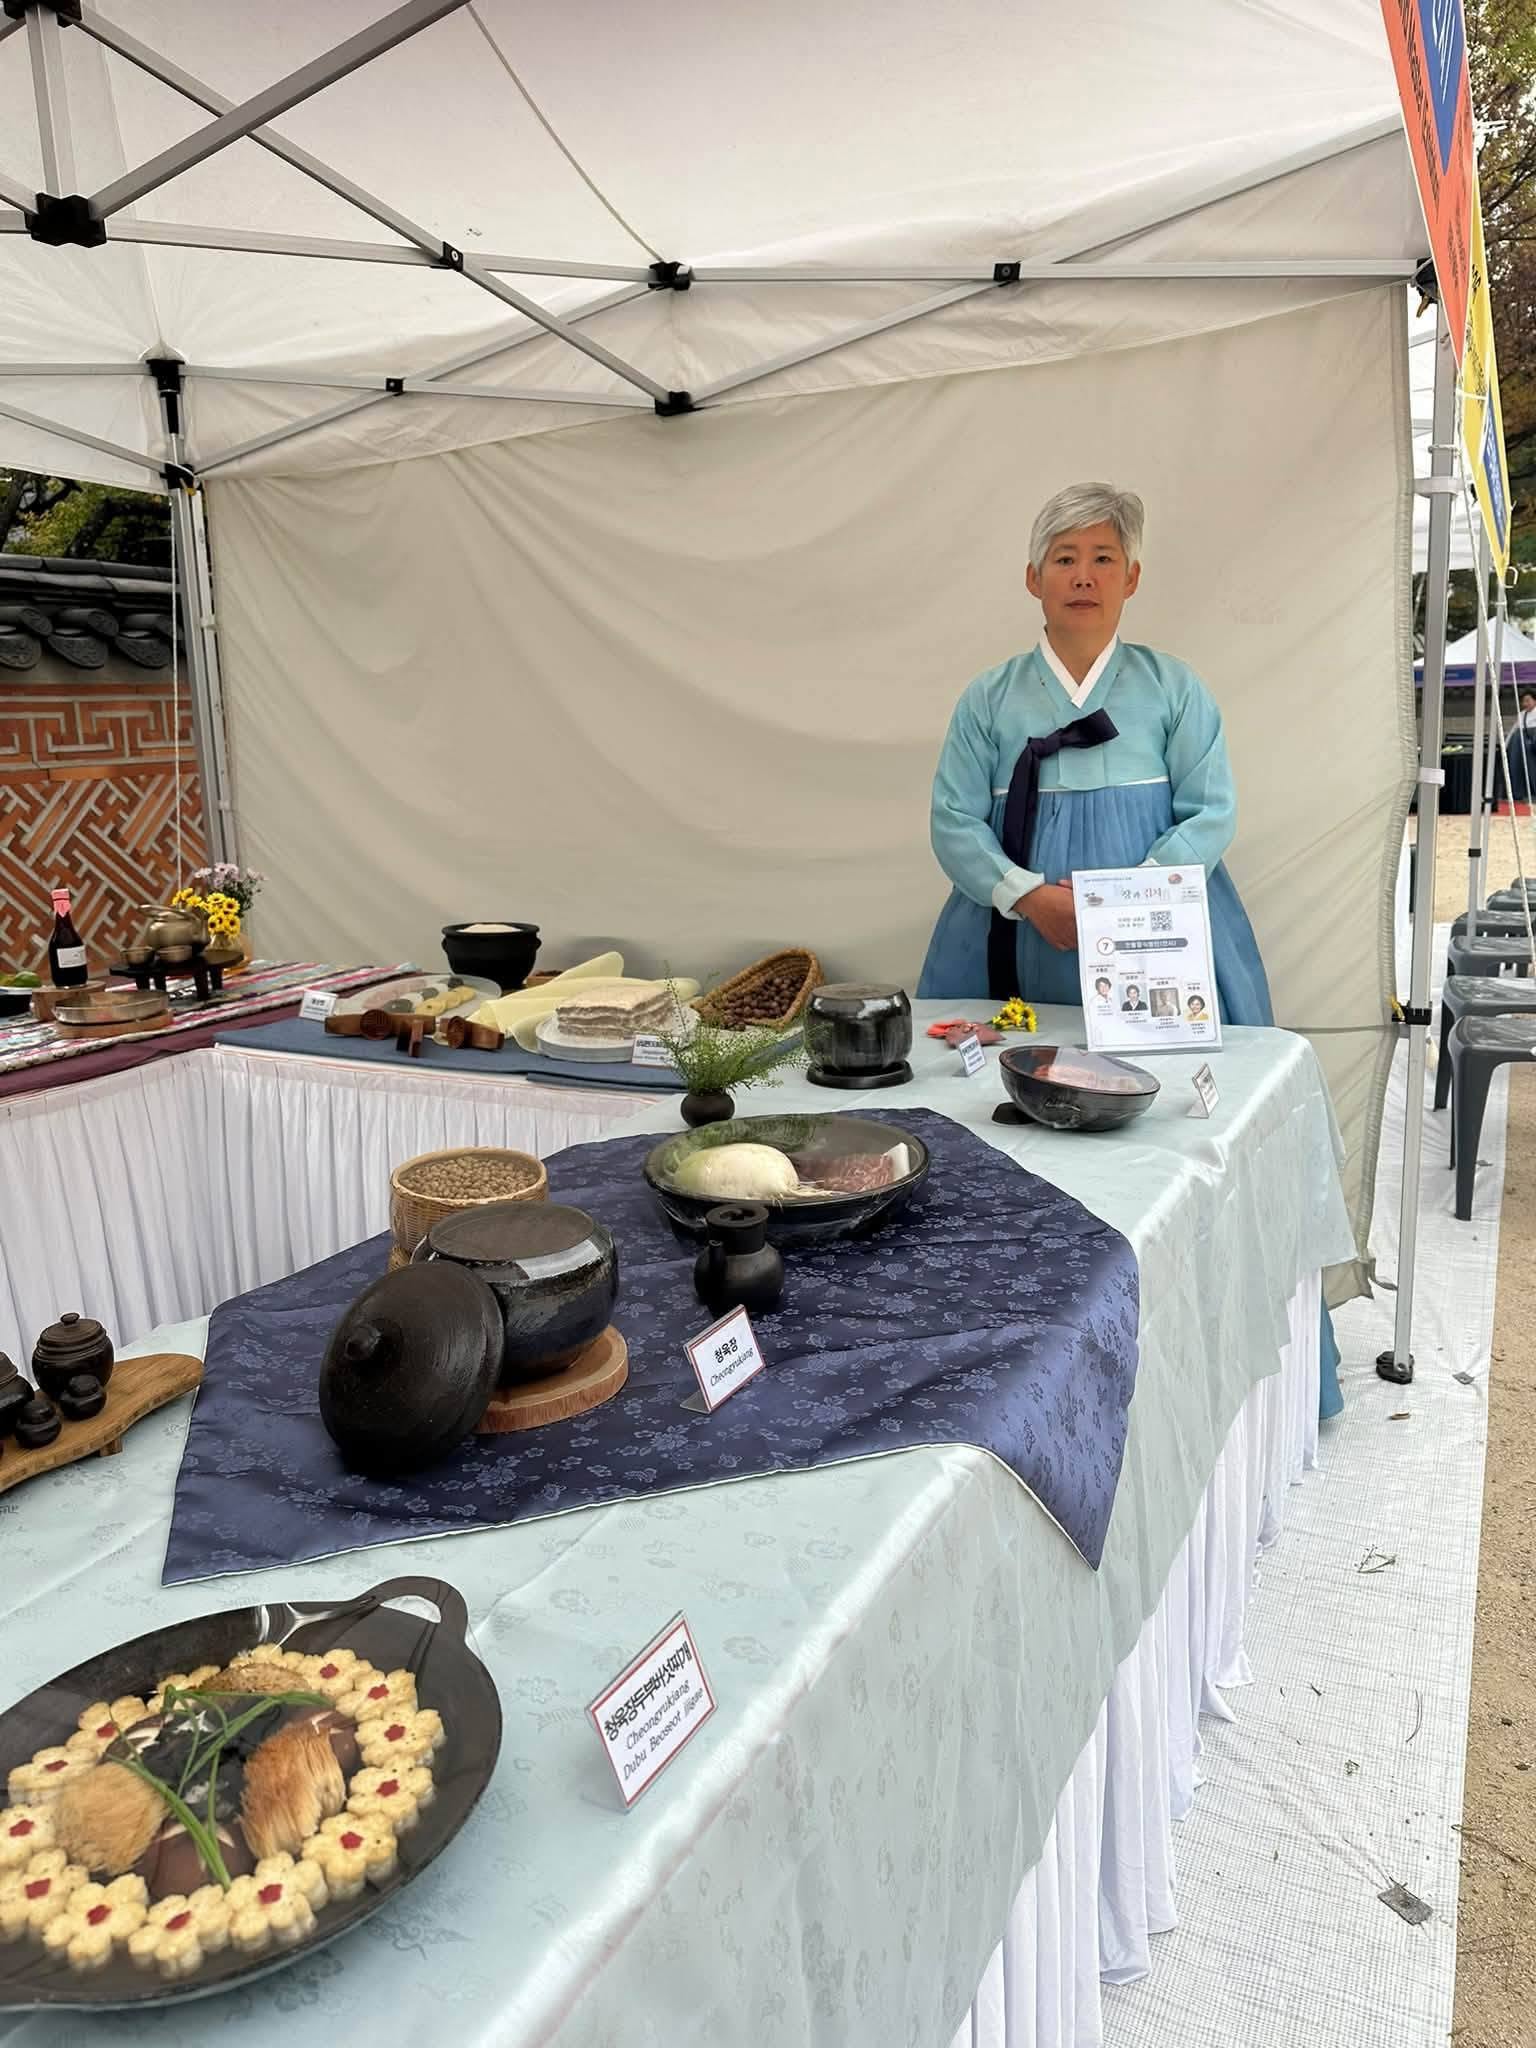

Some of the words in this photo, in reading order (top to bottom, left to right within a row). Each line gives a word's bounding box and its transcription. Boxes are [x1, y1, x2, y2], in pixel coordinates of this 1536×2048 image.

[714, 1337, 738, 1363] 청육장
[604, 1641, 693, 1741] 청육장두부버섯찌개
[624, 1749, 647, 1781] Dubu
[650, 1710, 682, 1752] Beoseot
